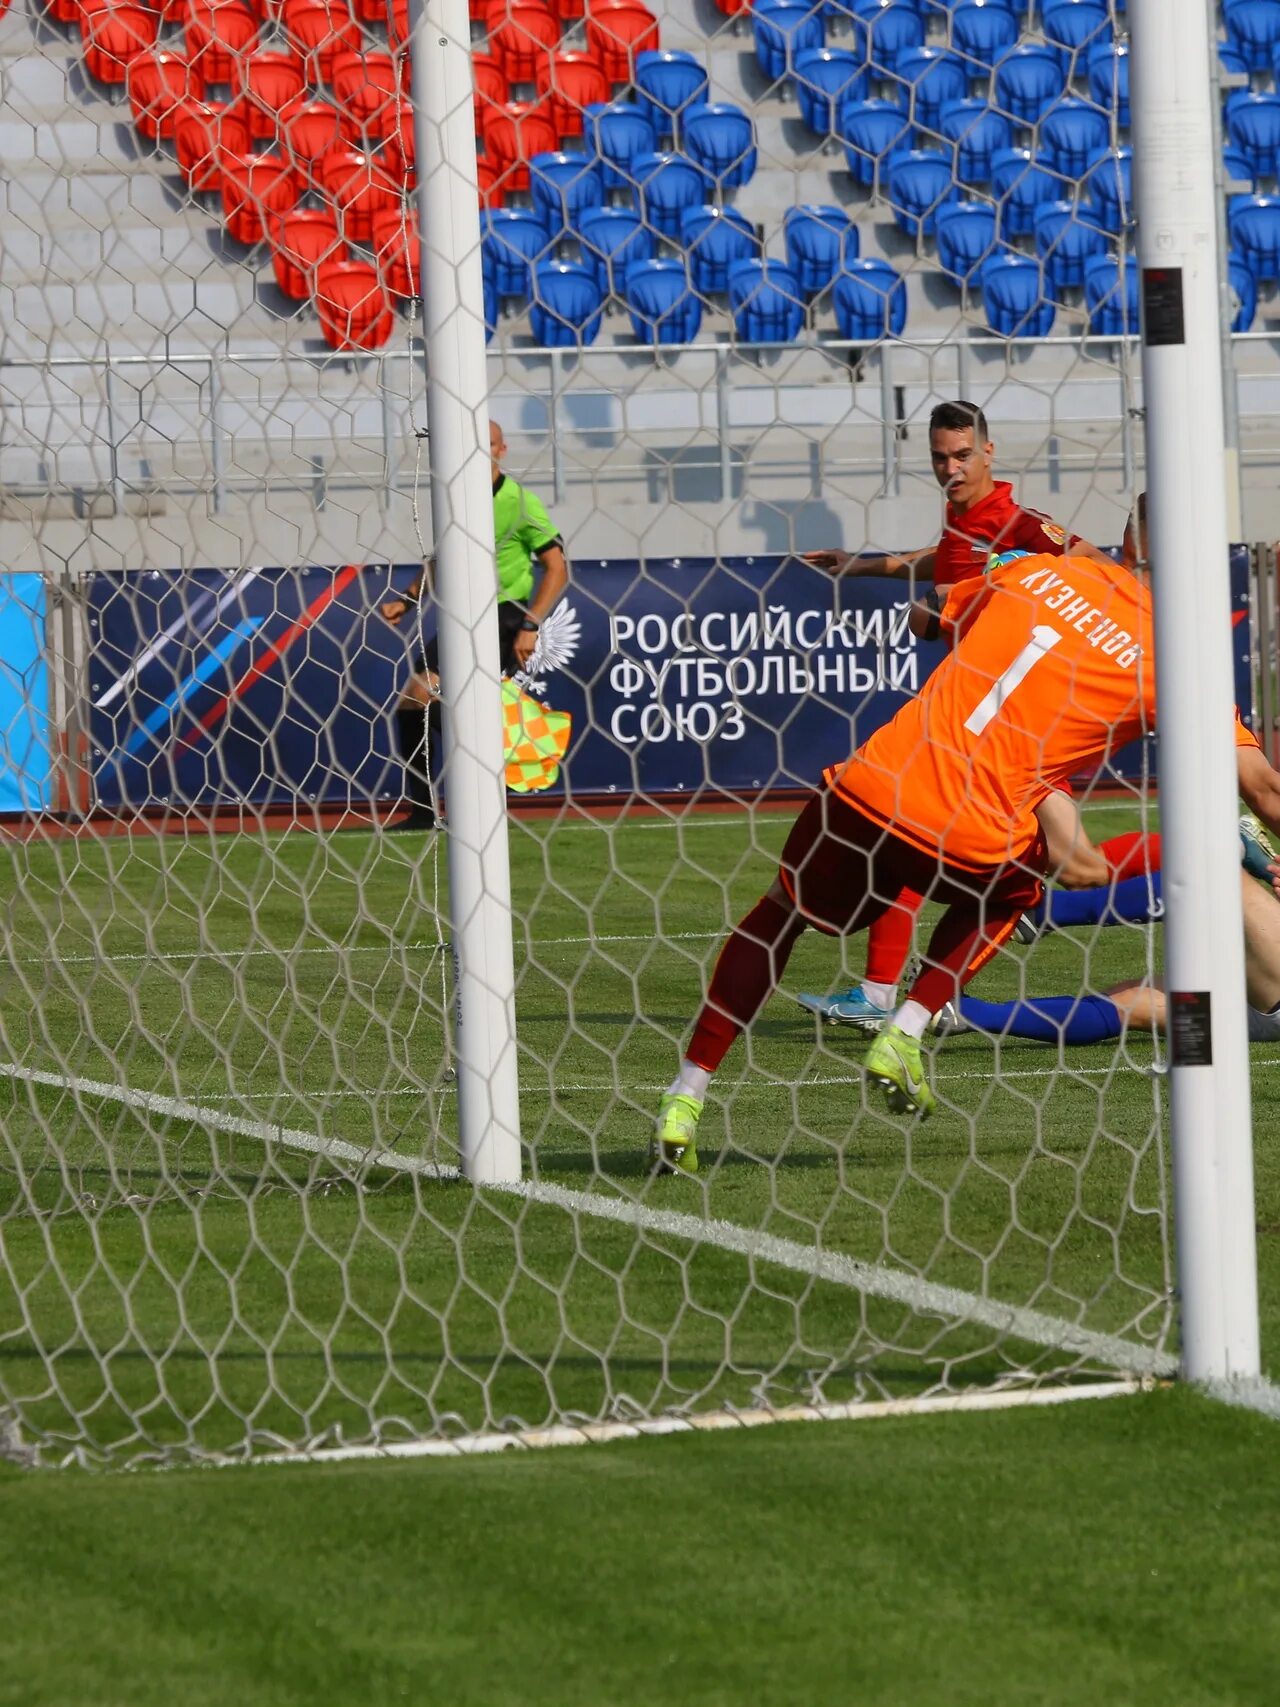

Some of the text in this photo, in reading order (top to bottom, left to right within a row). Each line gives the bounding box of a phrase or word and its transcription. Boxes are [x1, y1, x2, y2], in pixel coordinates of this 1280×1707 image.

[609, 602, 917, 654] РОССИЙСКИЙ
[1019, 567, 1144, 669] КУЗНЕЦОВ
[609, 645, 918, 698] ФУТБОЛЬНЫЙ
[963, 624, 1063, 736] 1
[610, 700, 746, 743] СОЮЗ
